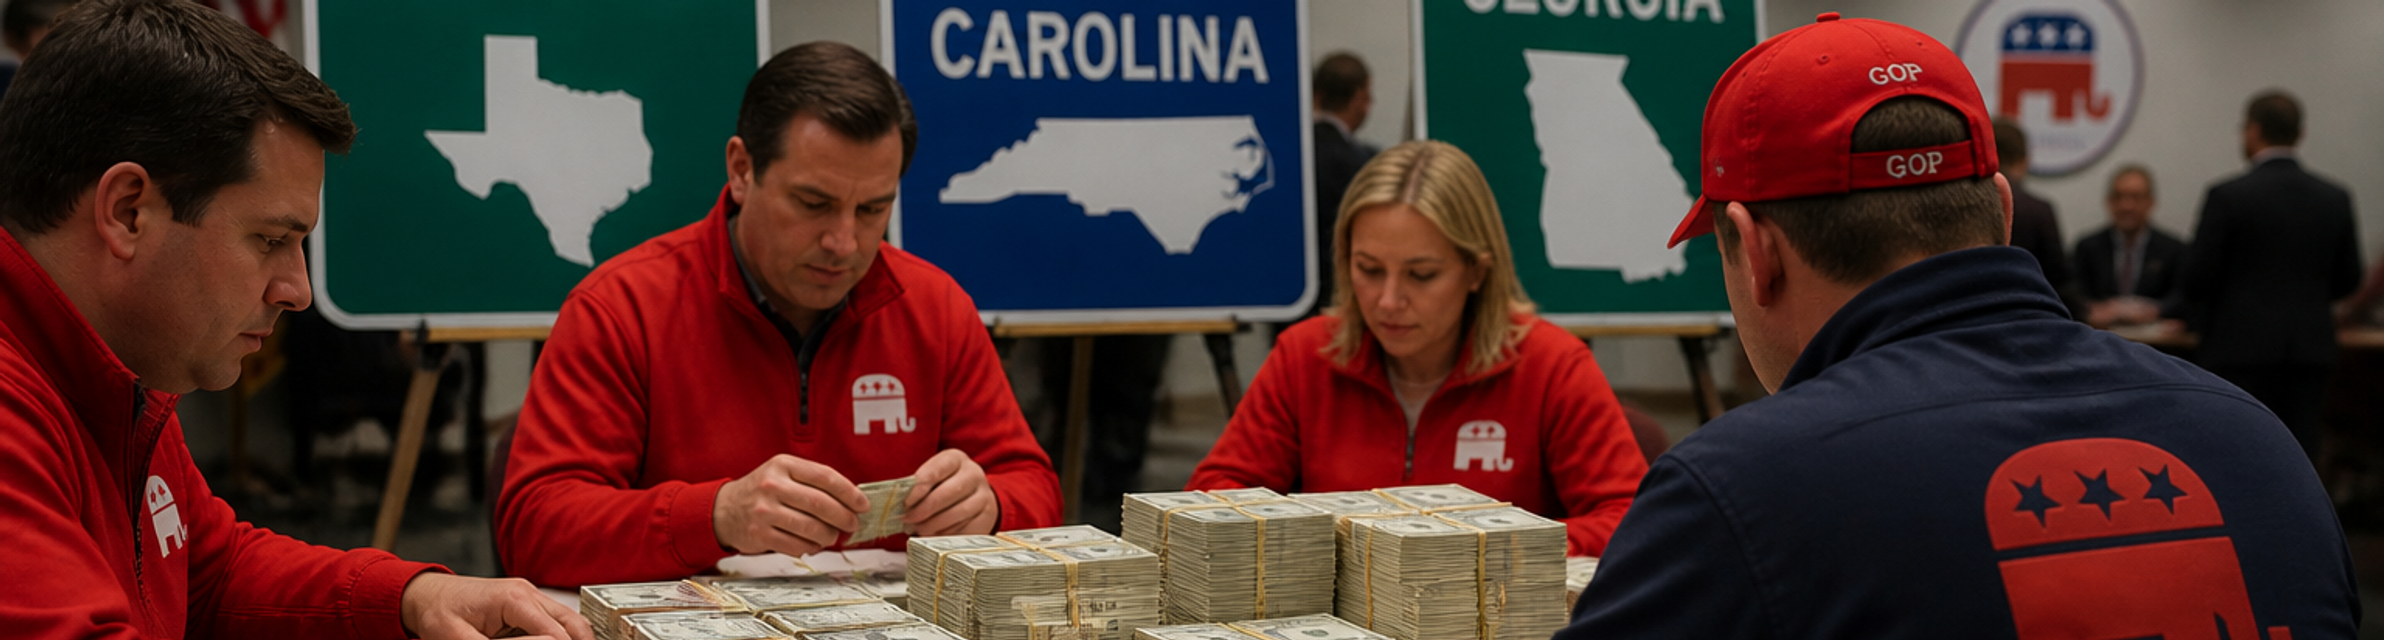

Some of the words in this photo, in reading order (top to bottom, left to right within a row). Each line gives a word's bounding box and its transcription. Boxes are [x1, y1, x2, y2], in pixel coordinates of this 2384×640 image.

[931, 7, 1269, 83] CAROLINA
[1869, 62, 1923, 86] GOP
[1886, 151, 1943, 178] GOP
